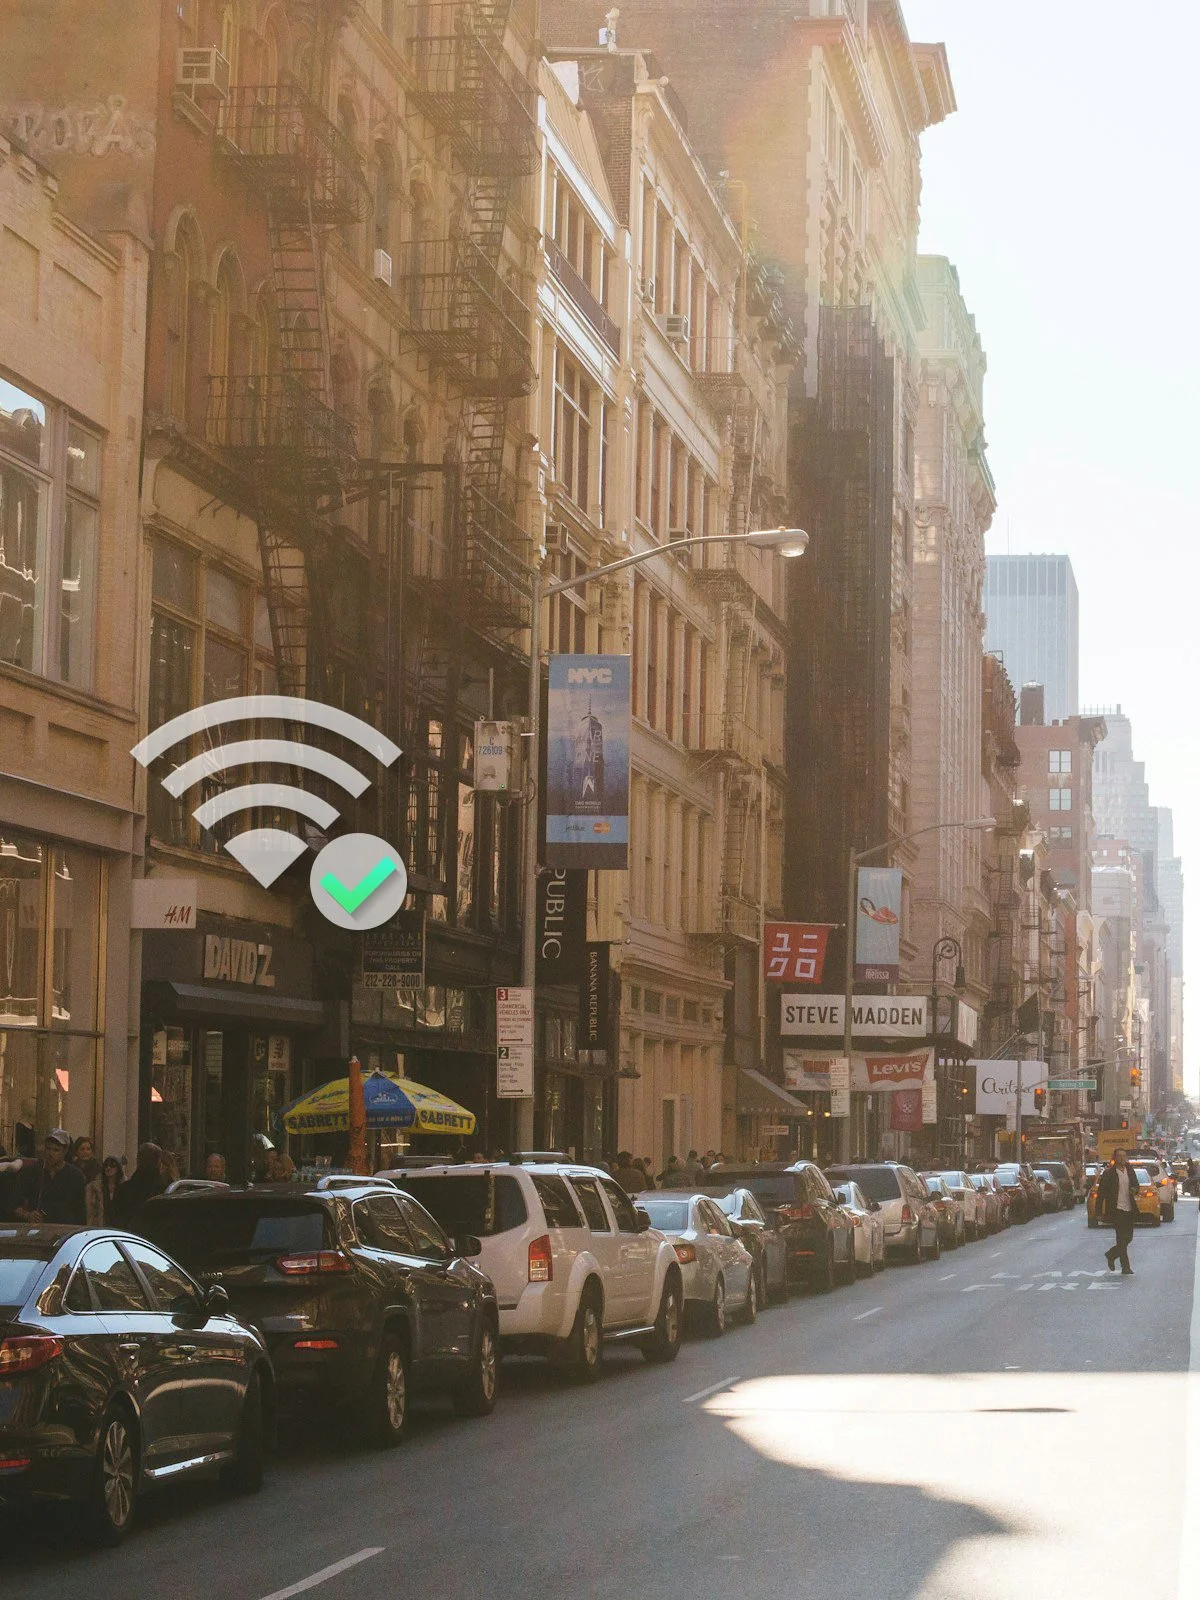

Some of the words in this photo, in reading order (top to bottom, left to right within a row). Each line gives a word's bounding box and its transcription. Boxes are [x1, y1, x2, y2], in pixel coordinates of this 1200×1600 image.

[568, 668, 612, 684] NYC
[164, 905, 192, 924] H&M
[204, 934, 258, 984] DAVID
[255, 943, 276, 987] Z
[589, 951, 598, 992] BANANA
[499, 989, 506, 1000] 3
[589, 994, 598, 1041] REPUBLIC
[785, 1005, 839, 1025] STEVE
[851, 1007, 922, 1026] MADDEN
[500, 1047, 507, 1059] 2
[288, 1112, 349, 1129] SABRETT
[420, 1109, 473, 1129] SABRETT
[960, 1282, 1123, 1292] FIRE
